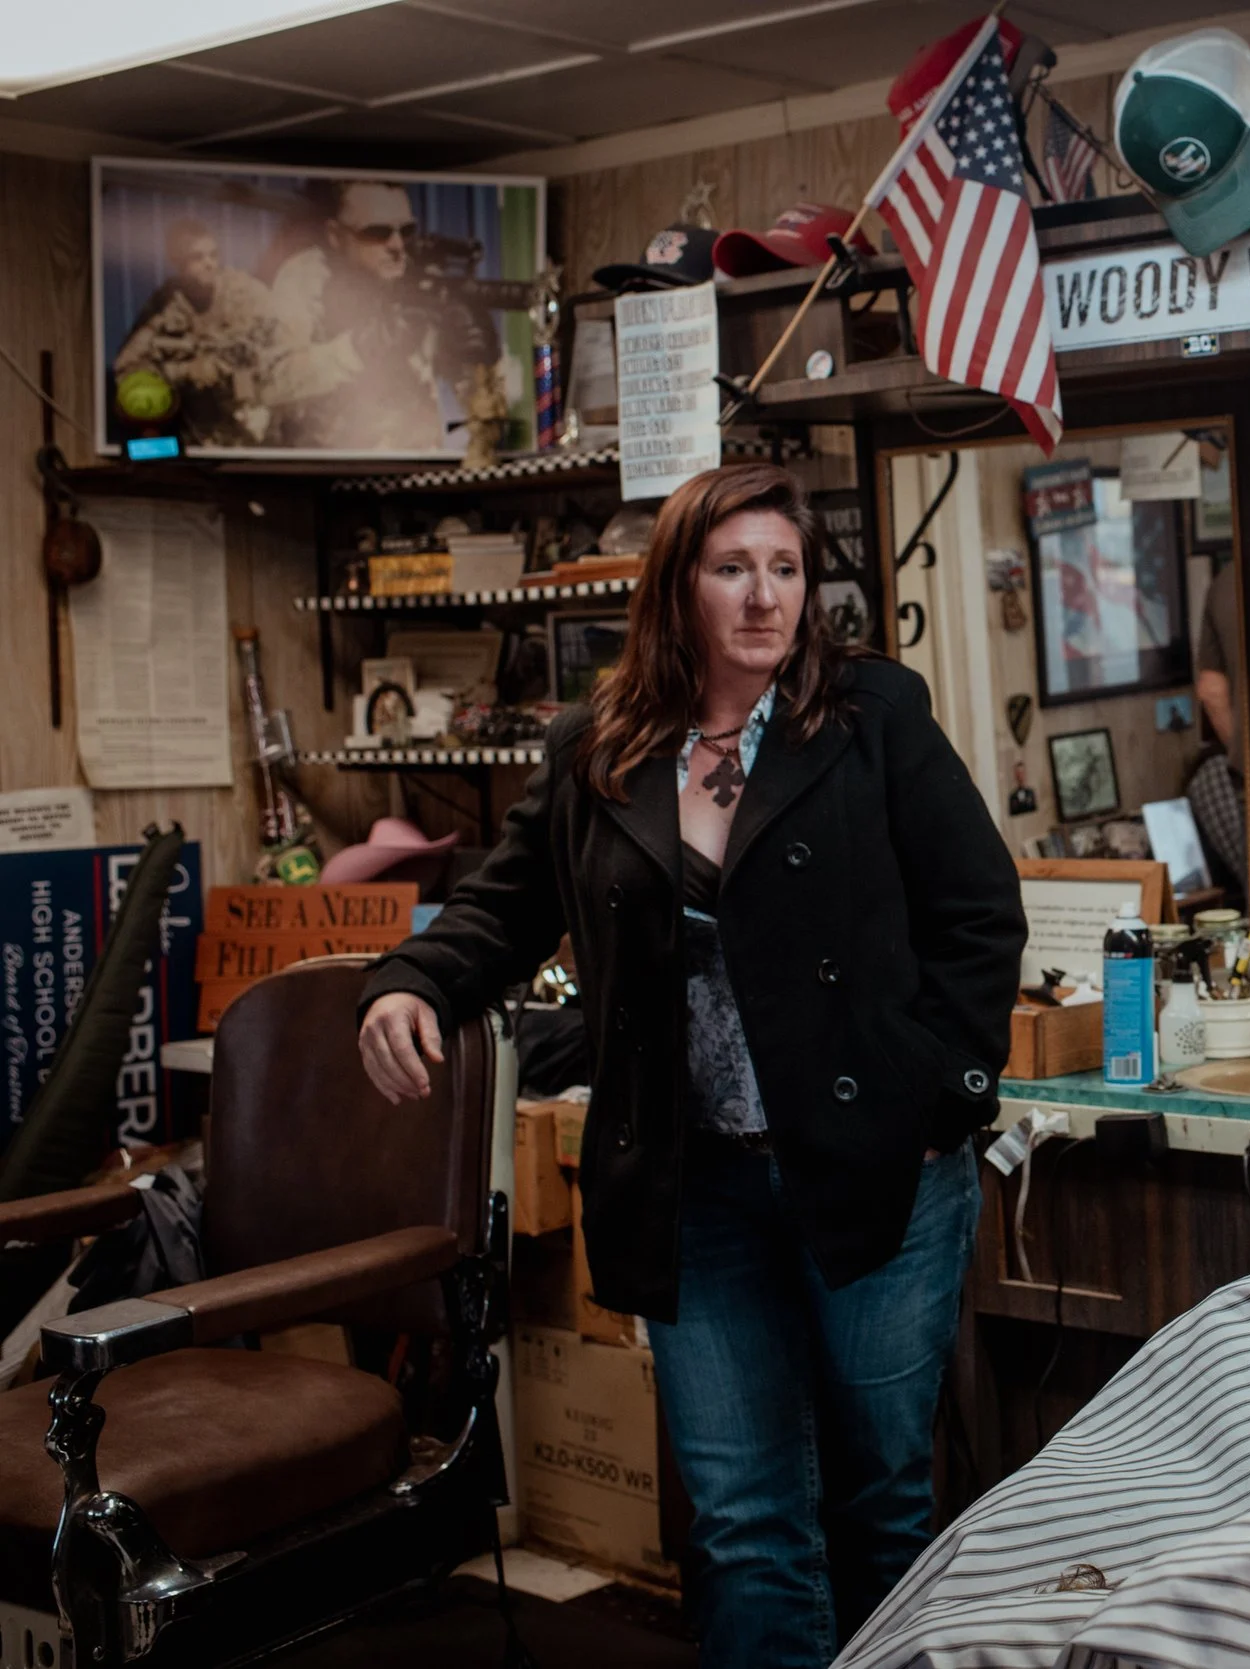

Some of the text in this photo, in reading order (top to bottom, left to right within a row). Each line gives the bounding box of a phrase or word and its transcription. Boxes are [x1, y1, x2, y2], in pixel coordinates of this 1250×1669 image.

[1056, 250, 1231, 330] WOODY
[31, 879, 54, 944] HIGH
[226, 890, 399, 929] SEE A NEED
[3, 942, 25, 1011] Board
[217, 940, 279, 977] FILL
[32, 951, 57, 1061] SCHOOL
[623, 1467, 654, 1494] WR
